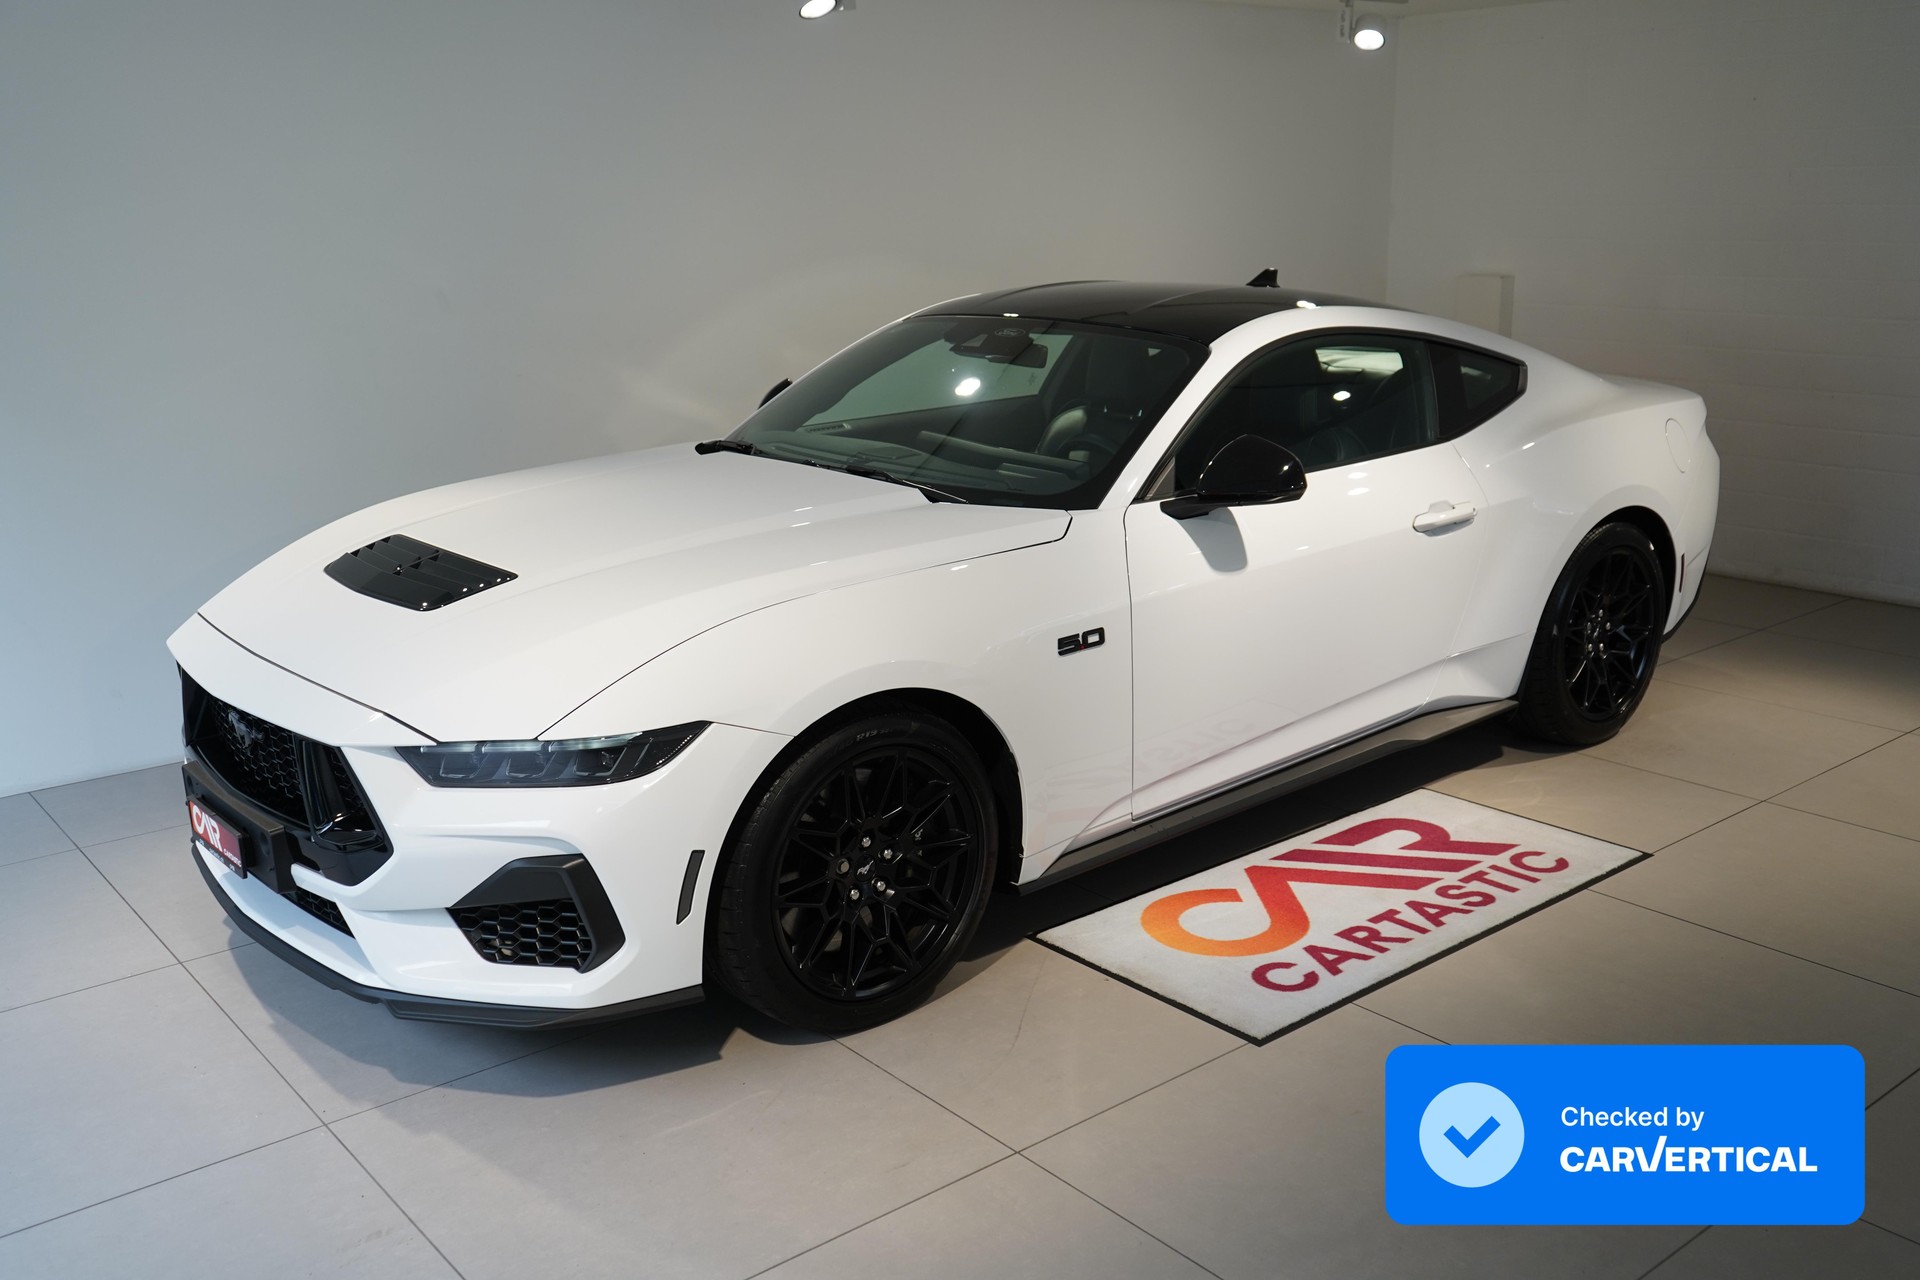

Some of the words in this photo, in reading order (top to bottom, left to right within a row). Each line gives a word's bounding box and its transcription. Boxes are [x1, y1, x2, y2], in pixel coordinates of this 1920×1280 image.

[1057, 626, 1106, 657] 5.0
[192, 804, 223, 852] CAR
[1140, 817, 1522, 957] CAR
[1250, 850, 1571, 993] CARTASTIC
